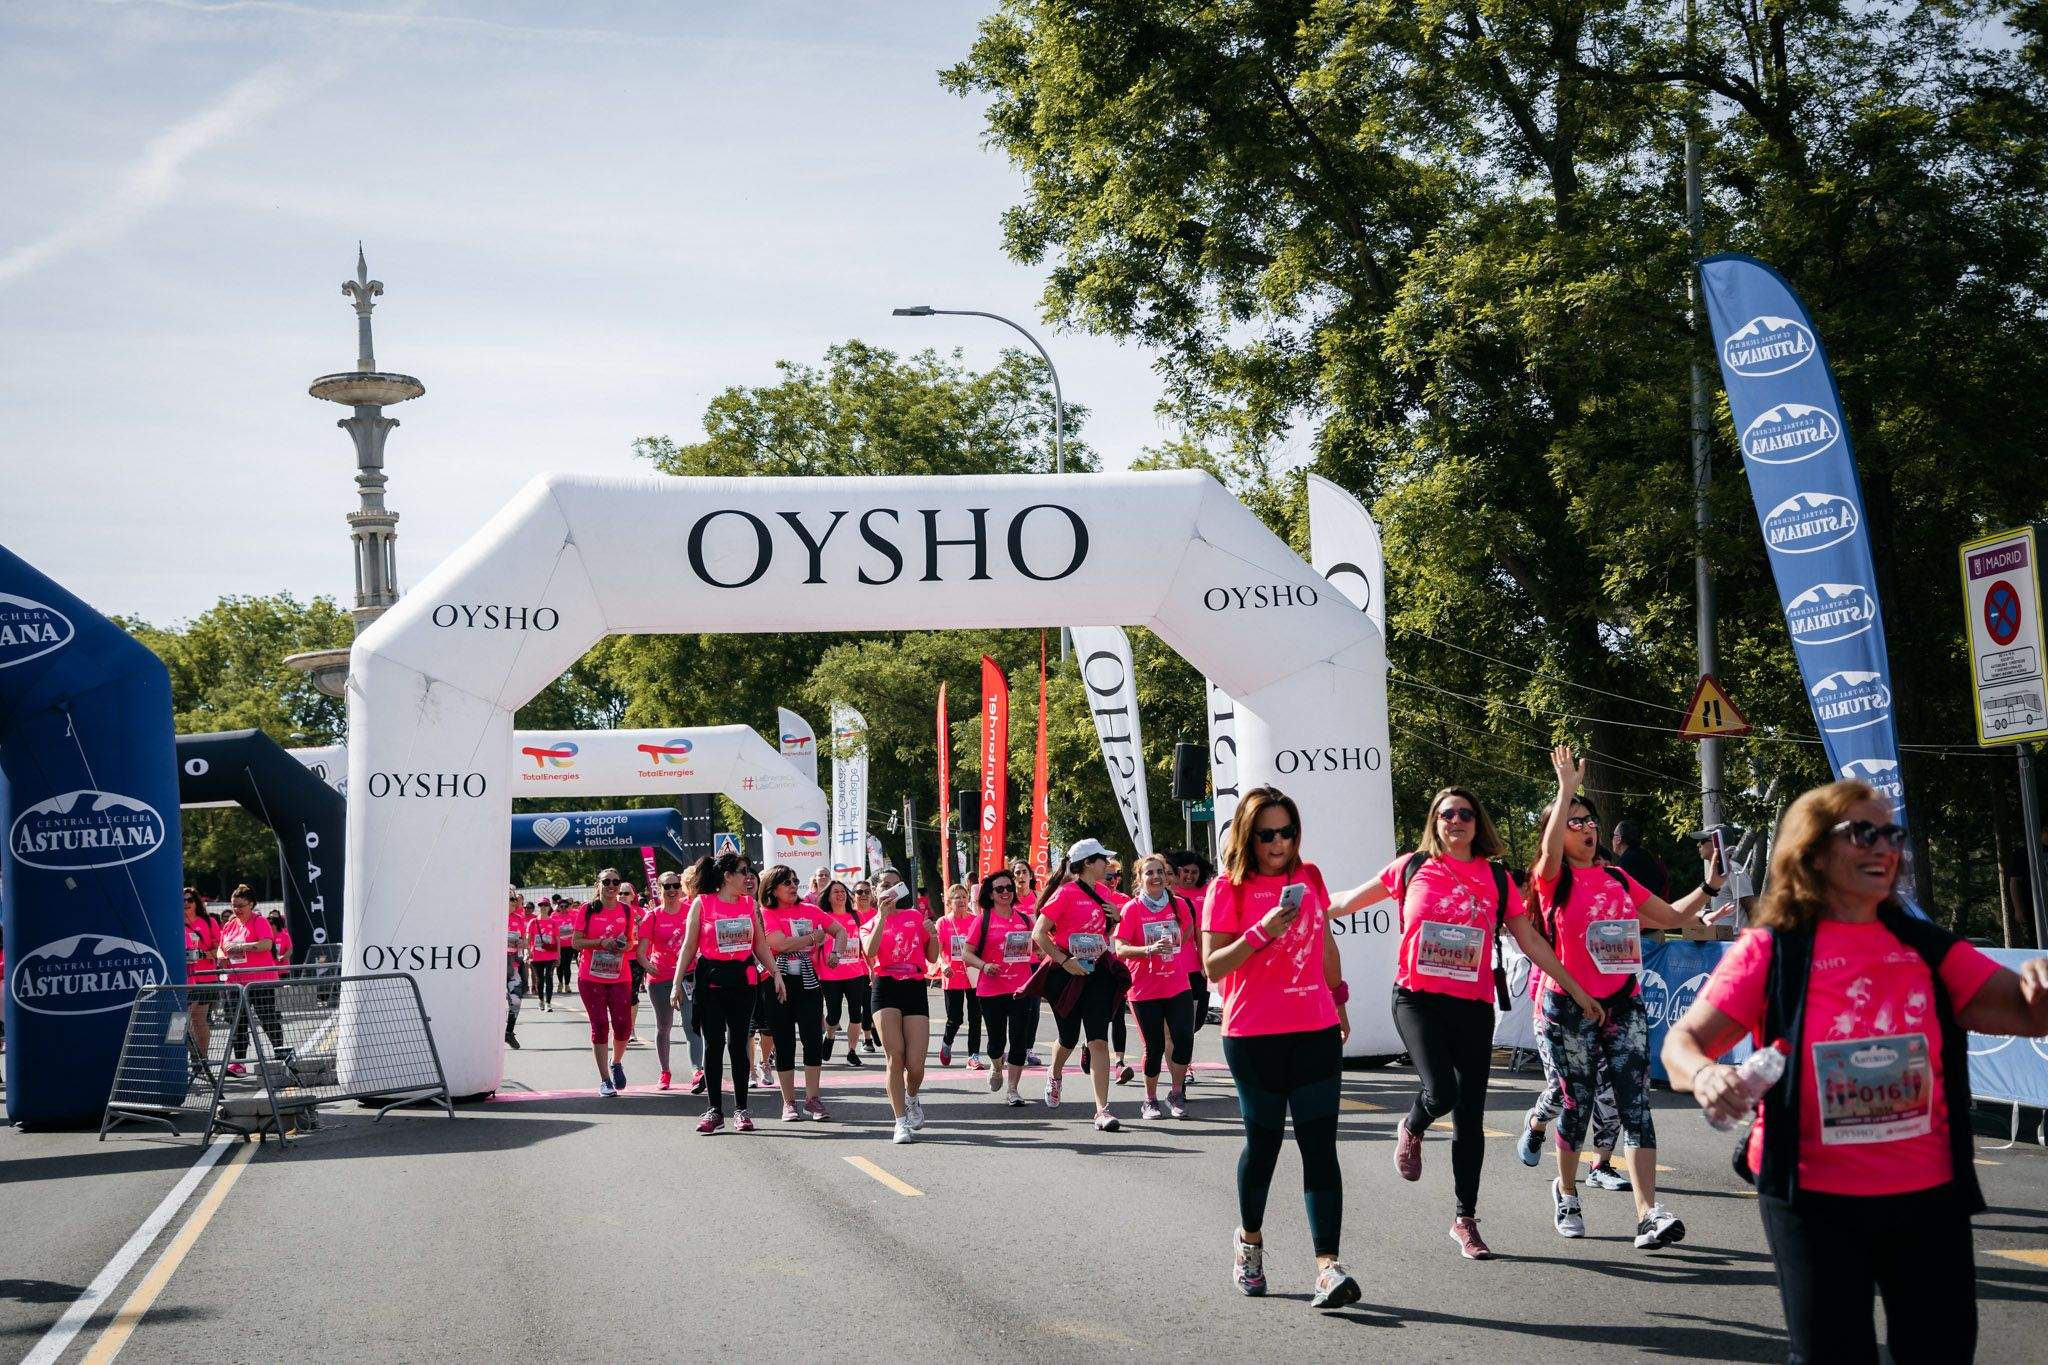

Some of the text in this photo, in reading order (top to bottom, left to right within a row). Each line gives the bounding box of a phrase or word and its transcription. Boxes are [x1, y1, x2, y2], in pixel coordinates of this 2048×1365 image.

[687, 504, 1089, 588] OYSHO
[1985, 550, 2022, 570] MADRID
[1204, 585, 1318, 611] OYSHO
[432, 604, 559, 631] OYSHO
[1275, 747, 1381, 774] OYSHO
[522, 773, 580, 782] TotalEnergies
[638, 769, 694, 778] TotalEnergies
[368, 773, 487, 798] OYSHO
[37, 814, 151, 828] CENTRAL LECHERA
[585, 815, 628, 826] deporte
[17, 824, 157, 853] ASTURIANA
[584, 825, 615, 836] salud
[585, 836, 633, 847] felicidad
[777, 851, 823, 859] TotalEnergies
[38, 957, 153, 972] CENTRAL LECHERA
[363, 944, 481, 970] OYSHO
[18, 968, 158, 997] ASTURIANA
[1860, 1083, 1901, 1102] 016
